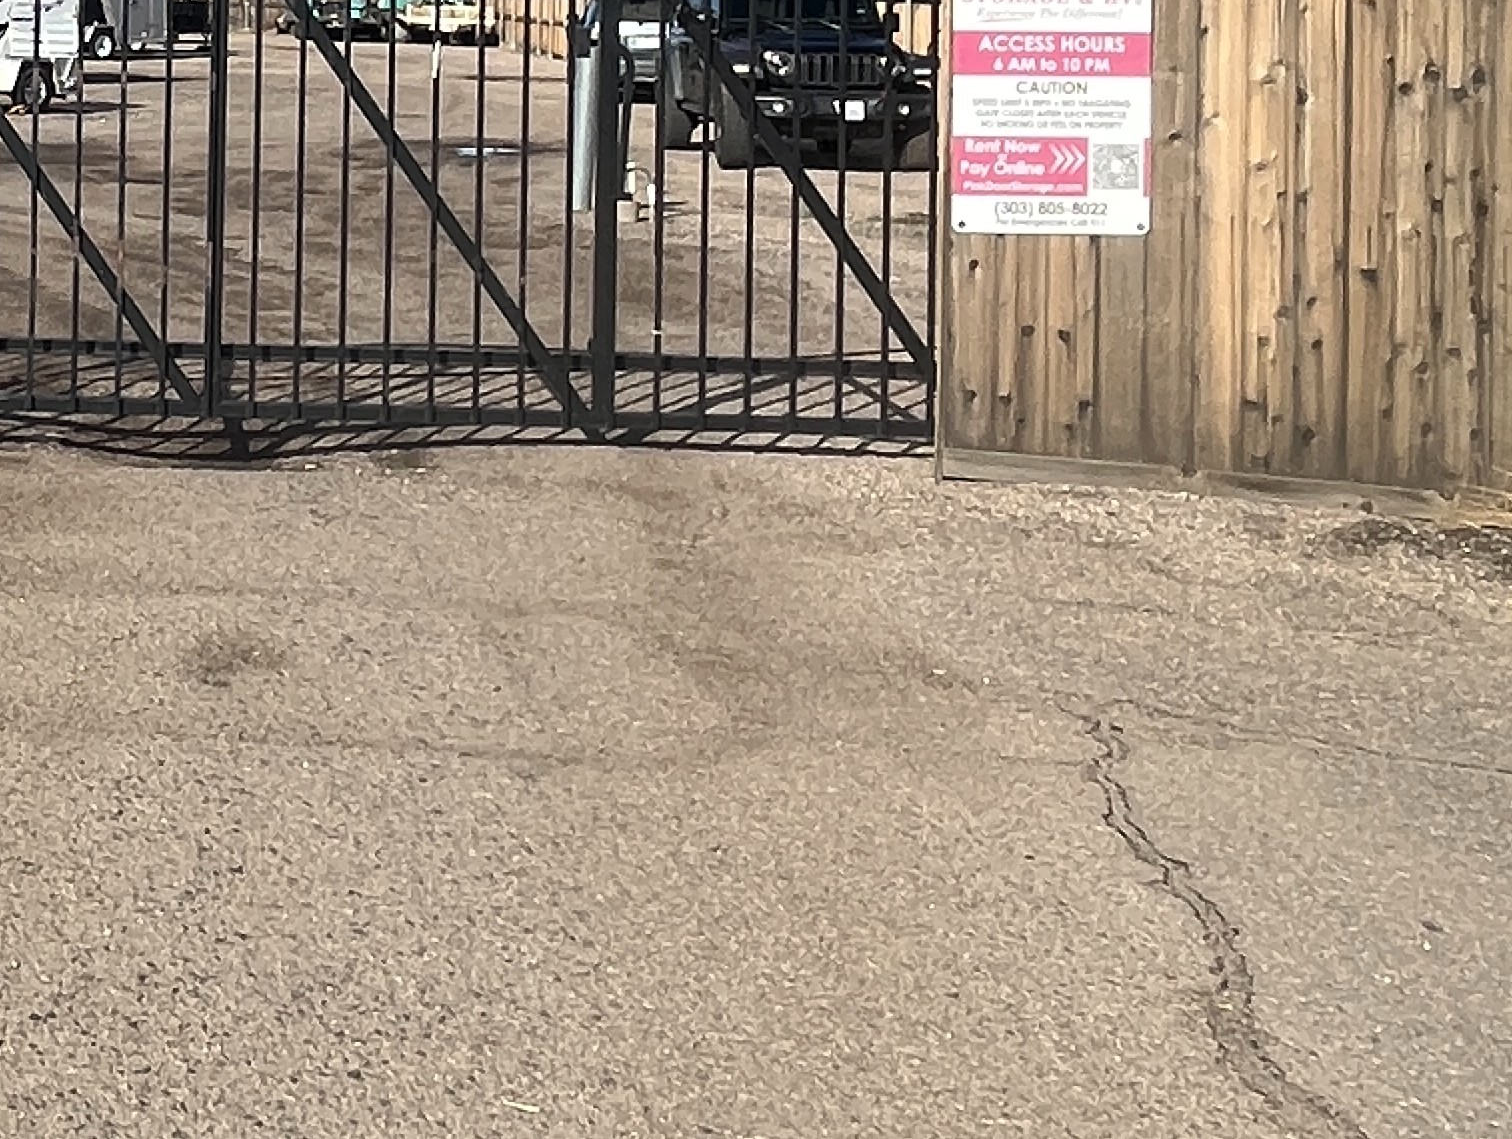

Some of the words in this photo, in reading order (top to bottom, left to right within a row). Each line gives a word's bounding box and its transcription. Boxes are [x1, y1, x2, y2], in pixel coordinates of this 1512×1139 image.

[978, 34, 1056, 53] ACCESS
[1060, 35, 1126, 53] HOURS
[993, 57, 1004, 71] 6
[1007, 57, 1037, 72] AM
[1040, 58, 1058, 72] to
[1062, 58, 1081, 72] 10
[1084, 58, 1111, 73] PM
[1016, 81, 1088, 95] CAUTION
[964, 138, 1002, 153] Rent
[1003, 139, 1042, 153] Now
[959, 159, 991, 179] Pay
[993, 160, 1046, 175] Online
[994, 201, 1033, 217] (303)
[1038, 201, 1108, 216] 805-8022
